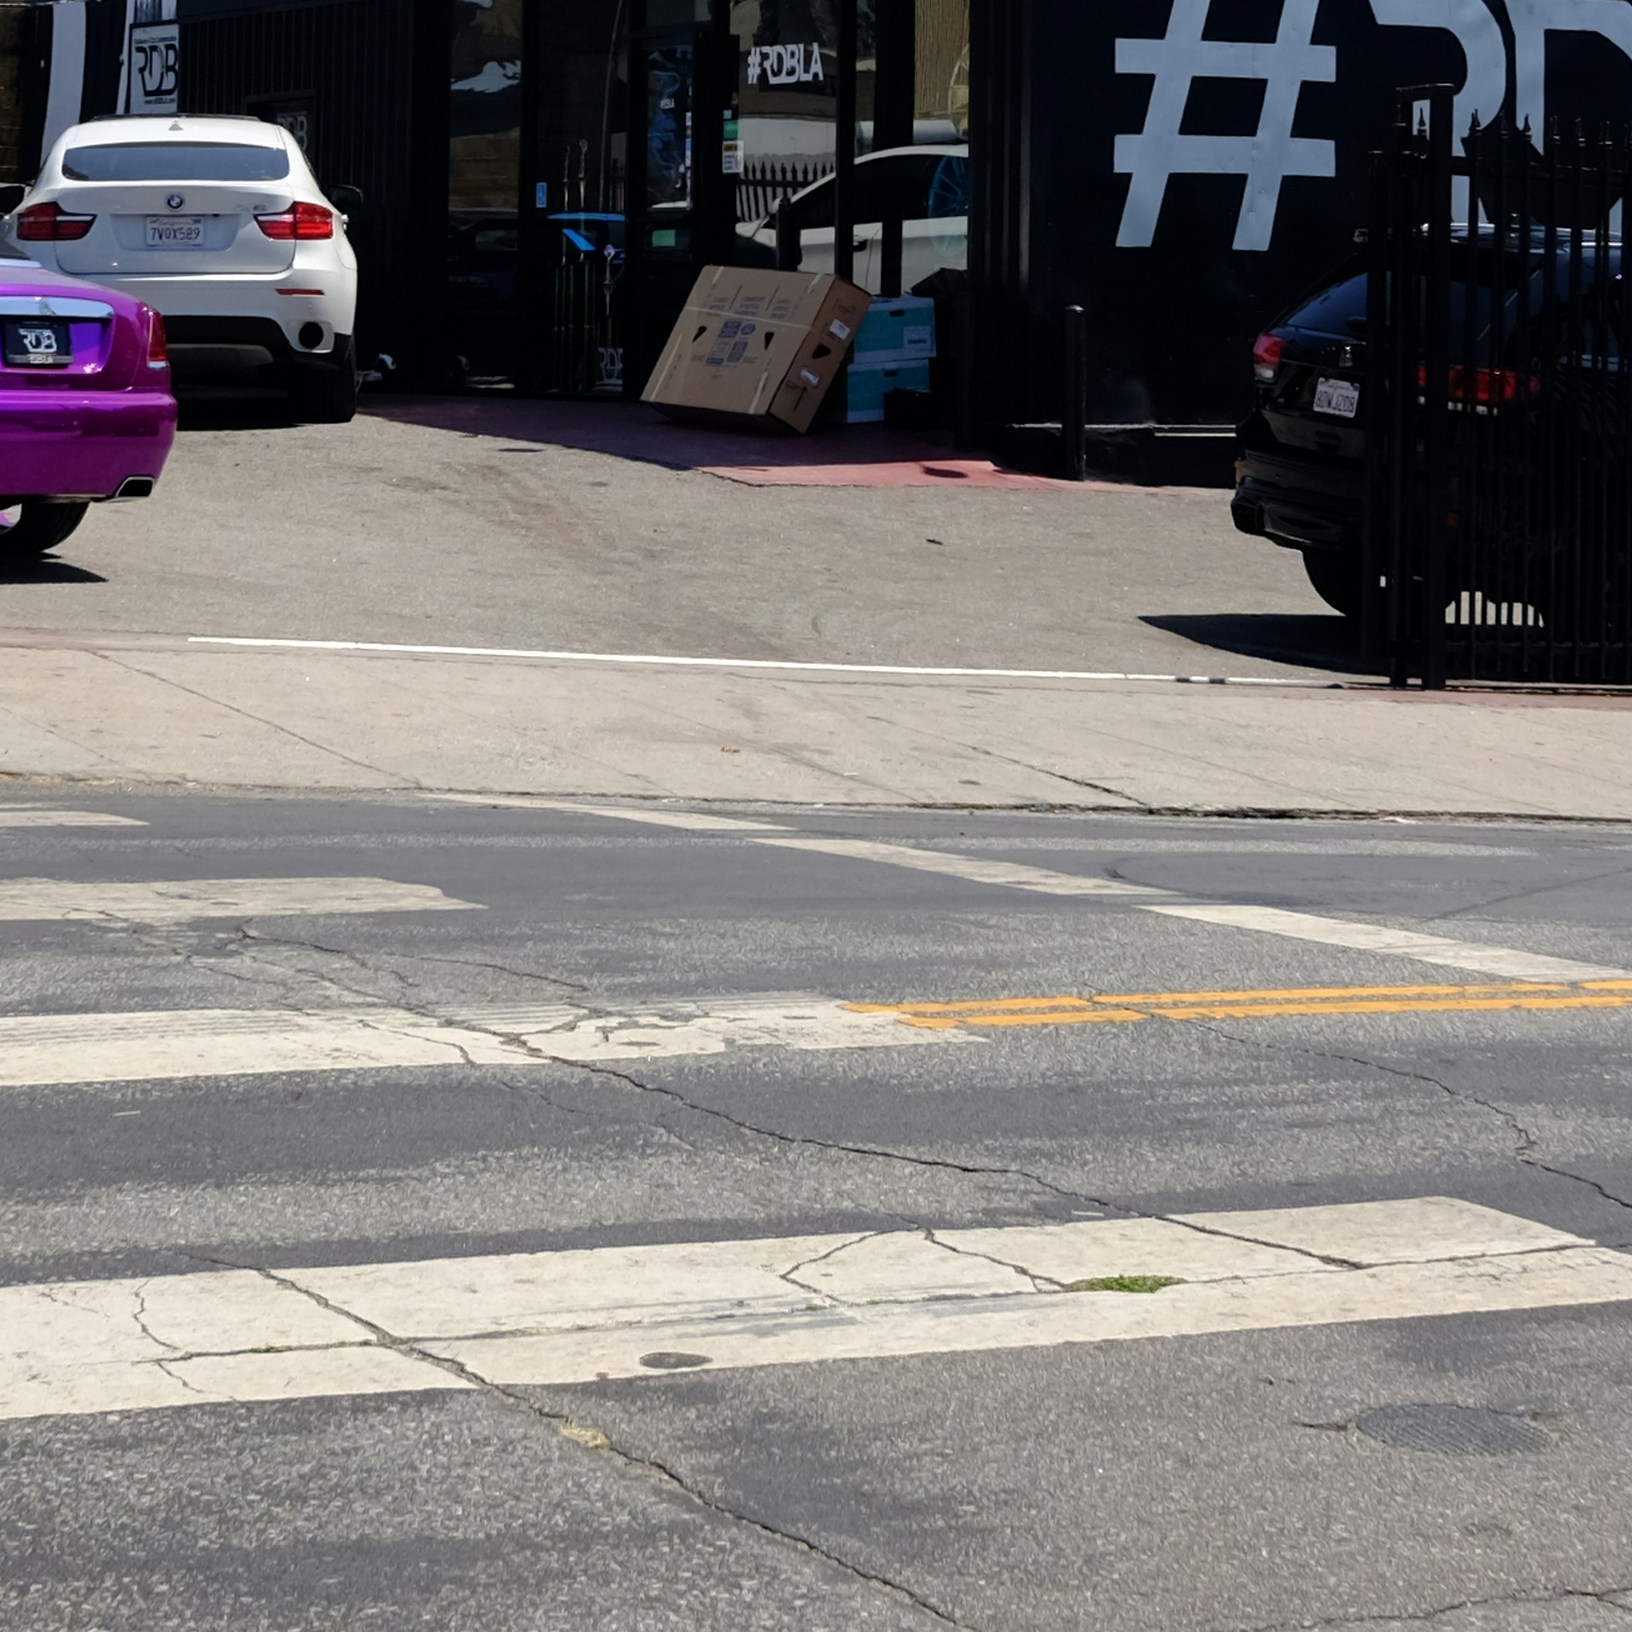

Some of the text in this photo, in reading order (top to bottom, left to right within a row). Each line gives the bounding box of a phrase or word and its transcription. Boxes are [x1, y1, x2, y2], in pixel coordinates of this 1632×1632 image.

[135, 43, 178, 97] RDB
[747, 41, 824, 85] #RDBLA
[19, 328, 57, 353] RDB
